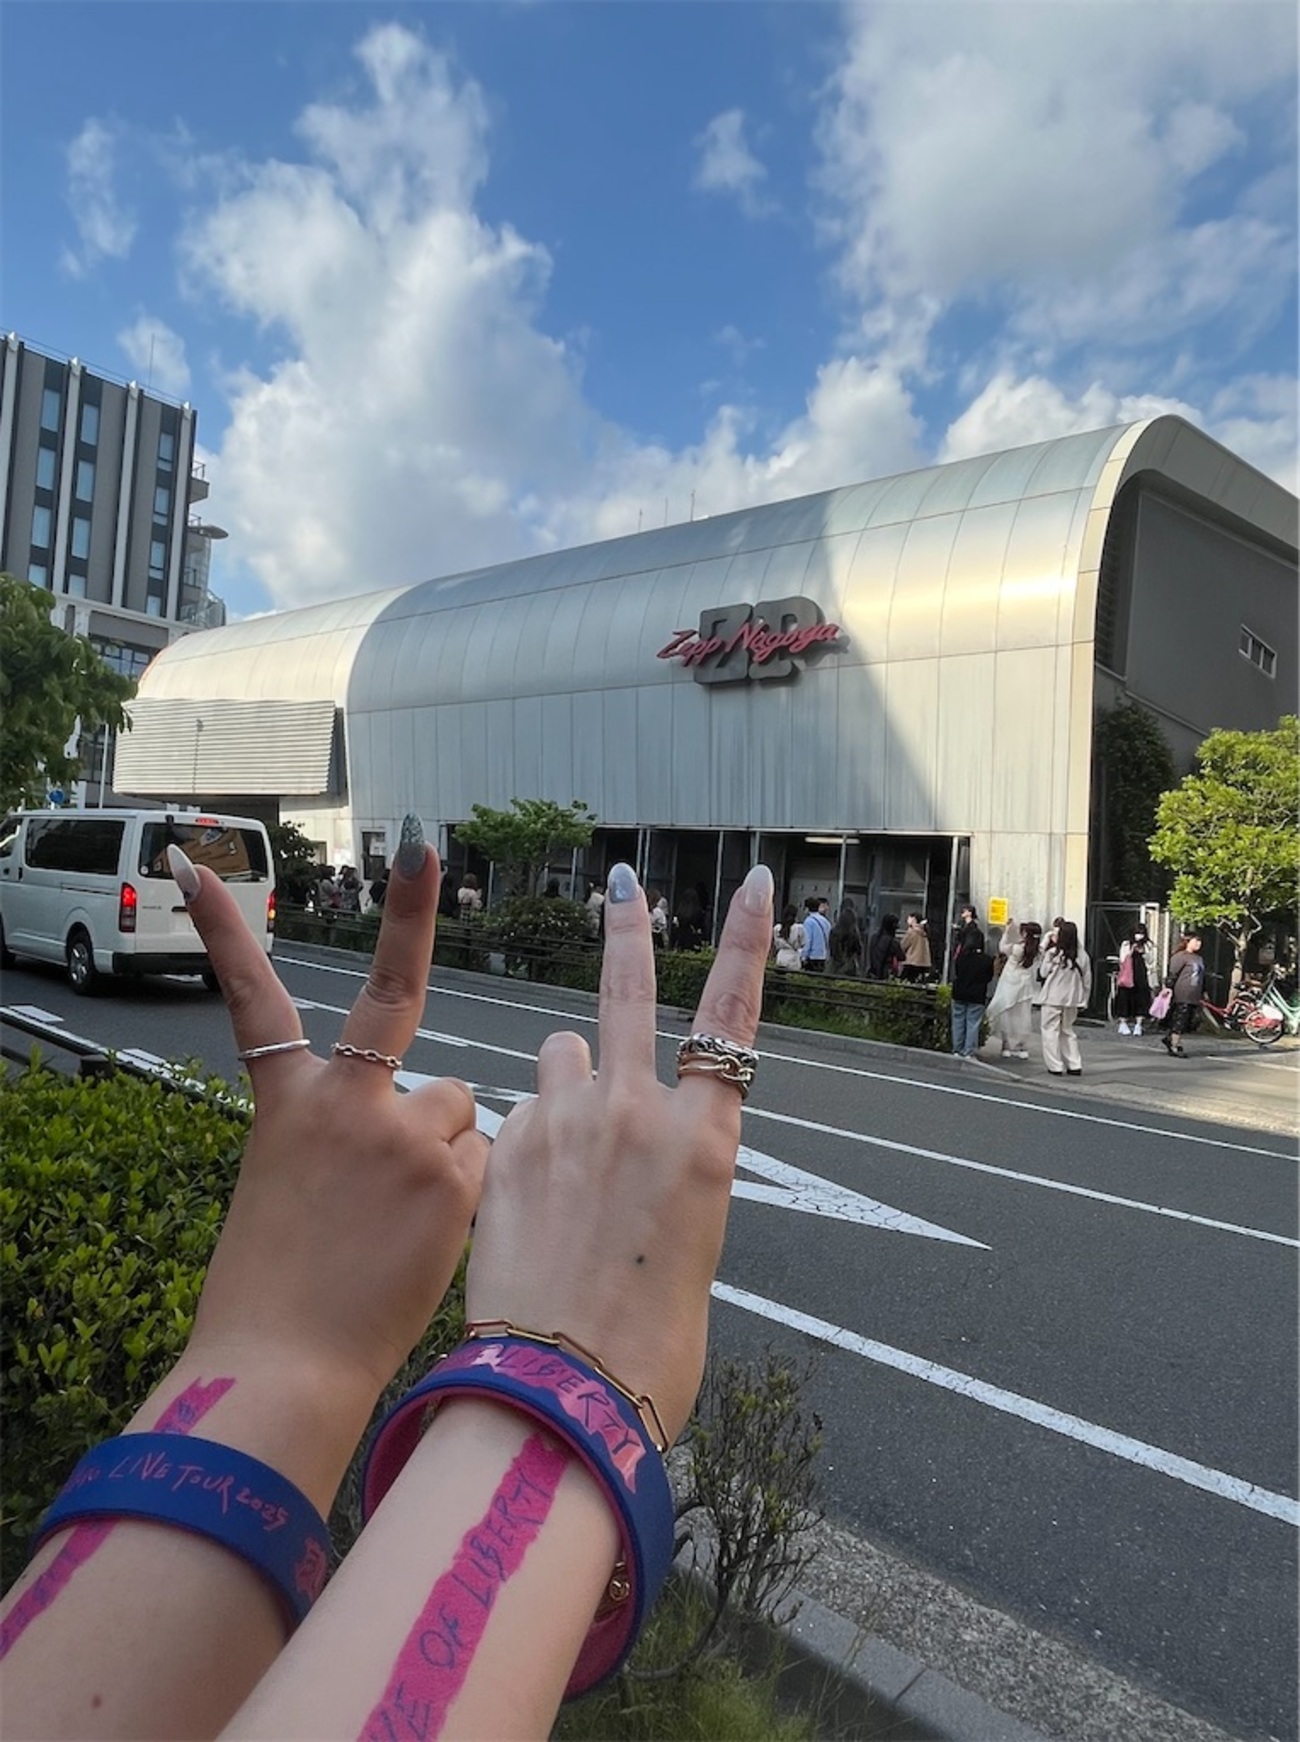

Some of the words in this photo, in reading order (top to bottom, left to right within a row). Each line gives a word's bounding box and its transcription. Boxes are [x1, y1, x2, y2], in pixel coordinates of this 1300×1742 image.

[656, 629, 725, 667] Zepp
[725, 621, 840, 664] Nagoya
[495, 1349, 641, 1454] LIBERTY
[108, 1451, 171, 1481] LIVE
[235, 1486, 290, 1533] 2025
[419, 1604, 464, 1670] OF
[452, 1467, 551, 1608] LIBERTY
